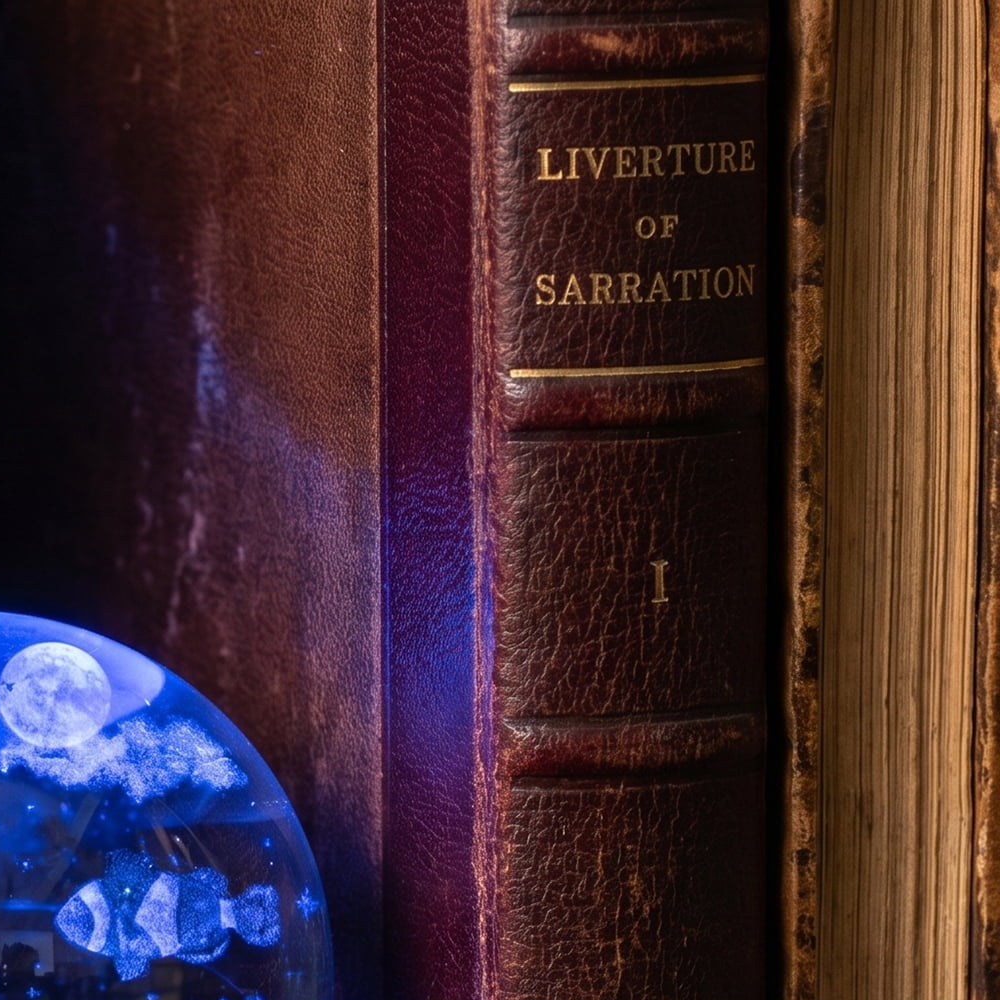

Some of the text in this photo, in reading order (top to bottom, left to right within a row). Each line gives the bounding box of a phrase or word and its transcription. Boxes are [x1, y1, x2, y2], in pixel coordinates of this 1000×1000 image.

[537, 139, 756, 181] LIVERTURE
[634, 214, 679, 239] OF
[535, 264, 756, 306] SARRATION
